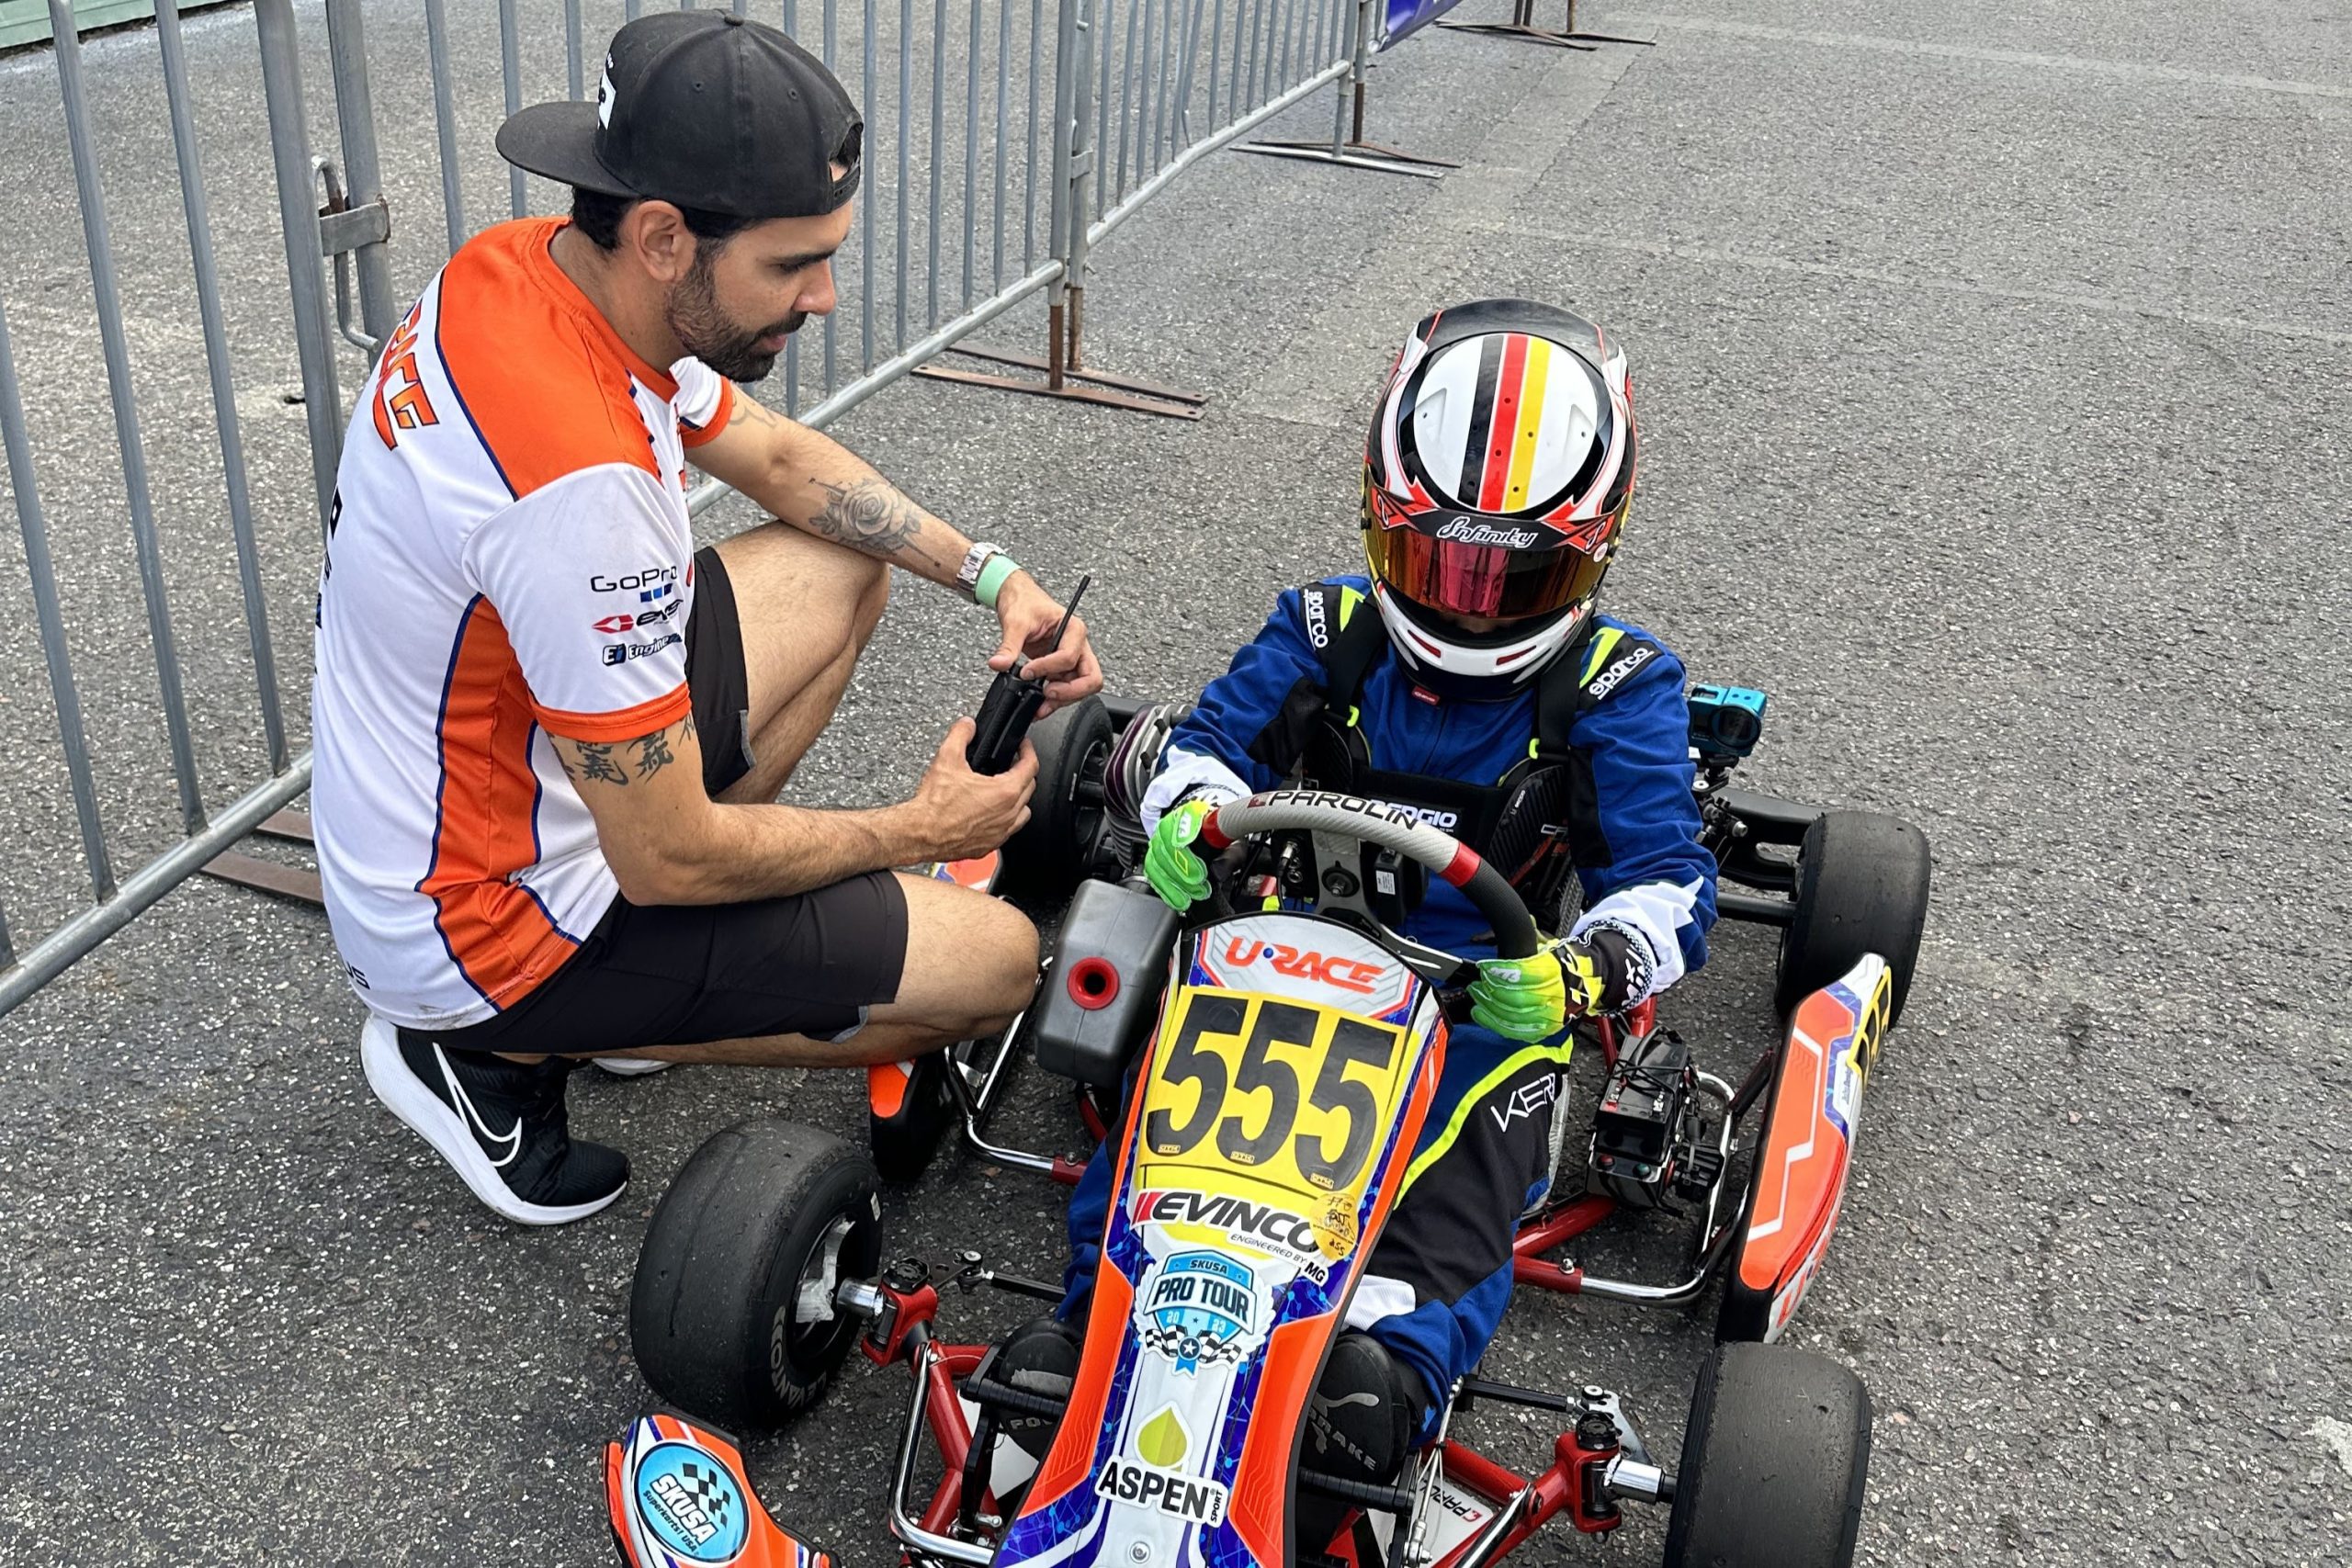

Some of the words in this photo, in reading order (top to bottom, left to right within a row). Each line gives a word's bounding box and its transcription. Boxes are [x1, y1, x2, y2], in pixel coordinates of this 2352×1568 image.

[591, 566, 677, 592] GoPro
[1589, 648, 1654, 700] sparco
[1269, 790, 1419, 830] PAROLIN
[1146, 993, 1397, 1191] 555
[1152, 1191, 1320, 1253] EVINCO
[1230, 1233, 1293, 1259] ENGINEERED
[1190, 1259, 1227, 1275] SKUSA
[1305, 1261, 1326, 1282] MG
[1152, 1276, 1196, 1306] PRO
[1201, 1278, 1250, 1325] TOUR
[1166, 1311, 1180, 1324] 20
[650, 1472, 718, 1546] SKUSA
[1098, 1461, 1209, 1519] ASPEN
[1210, 1489, 1223, 1523] SPORT
[681, 1535, 697, 1552] USA
